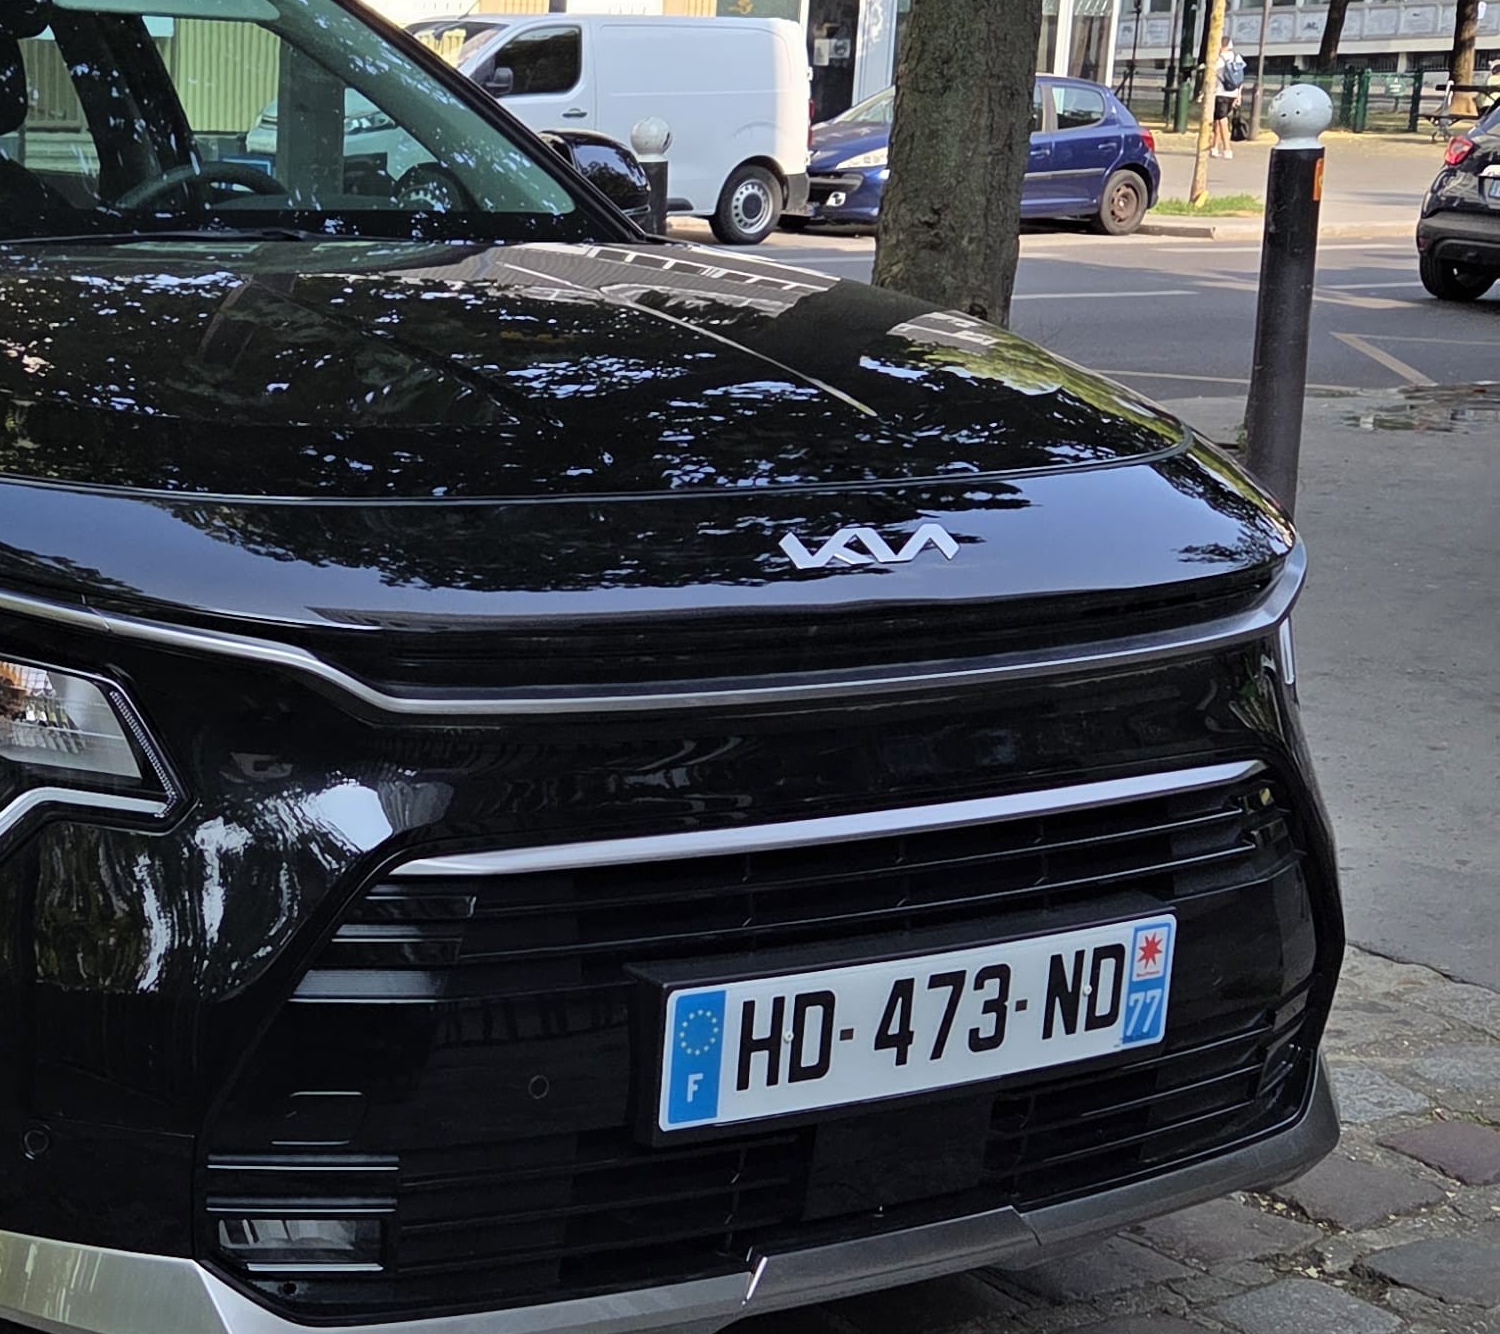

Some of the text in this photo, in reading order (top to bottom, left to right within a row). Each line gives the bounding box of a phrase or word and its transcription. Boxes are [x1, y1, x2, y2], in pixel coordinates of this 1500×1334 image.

[778, 523, 961, 569] KIA
[736, 942, 1127, 1092] HD-473-ND
[1126, 988, 1163, 1037] 77
[685, 1072, 705, 1104] F
